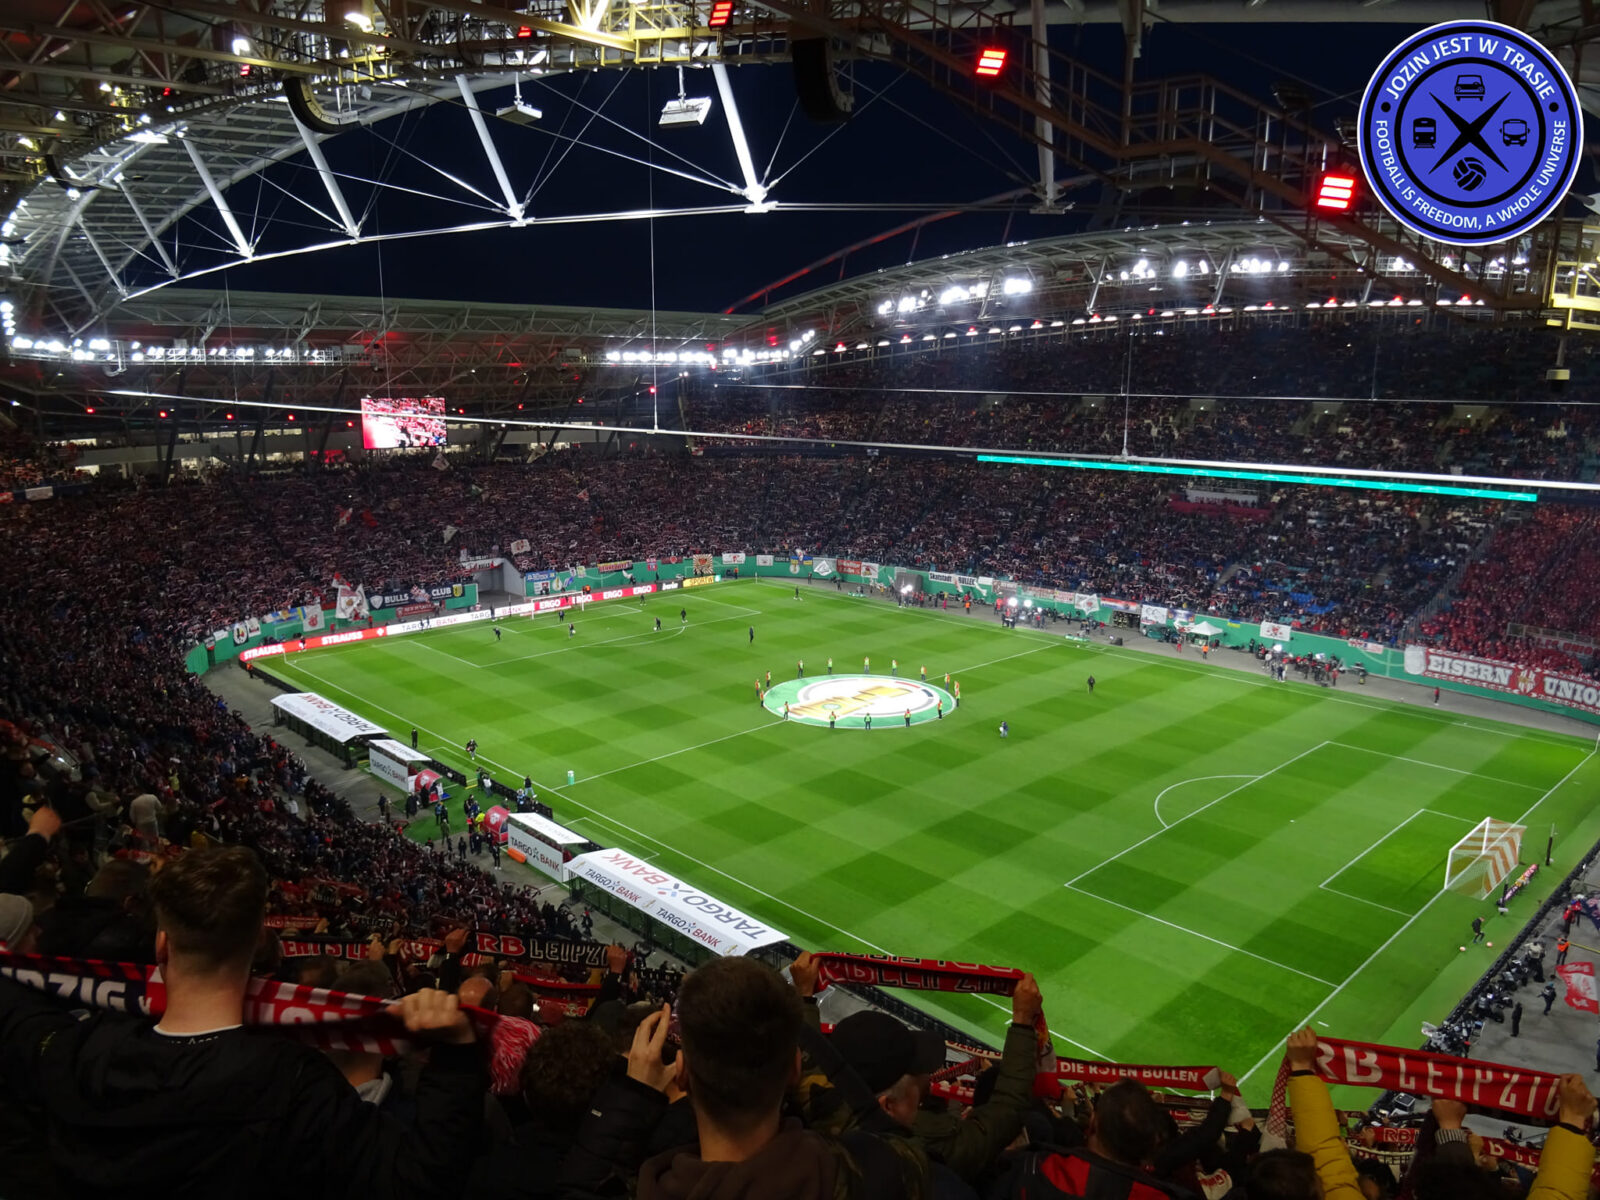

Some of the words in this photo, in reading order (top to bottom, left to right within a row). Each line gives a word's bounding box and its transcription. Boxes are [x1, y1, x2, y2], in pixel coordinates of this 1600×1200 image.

[384, 593, 409, 604] BULLS
[431, 587, 452, 597] CLUB
[540, 599, 561, 609] ERGO
[603, 590, 623, 599] ERGO
[633, 586, 652, 595] ERGO
[244, 643, 284, 660] STRAUSS
[321, 631, 363, 645] STRAUSS
[1427, 654, 1513, 685] EISERN
[1543, 675, 1600, 706] UNIO
[510, 836, 532, 856] TARGO
[540, 853, 560, 872] BANK
[602, 852, 670, 886] BANK
[584, 868, 612, 889] TARGO
[615, 885, 642, 904] BANK
[656, 907, 686, 929] TARGO
[692, 928, 722, 948] BANK
[683, 895, 768, 940] TARGO
[477, 933, 526, 956] RB
[529, 938, 609, 967] LEIPZI
[1060, 1061, 1084, 1073] DIE
[1142, 1068, 1199, 1083] BULLEN
[1316, 1041, 1383, 1083] RB
[1383, 1128, 1412, 1144] RB
